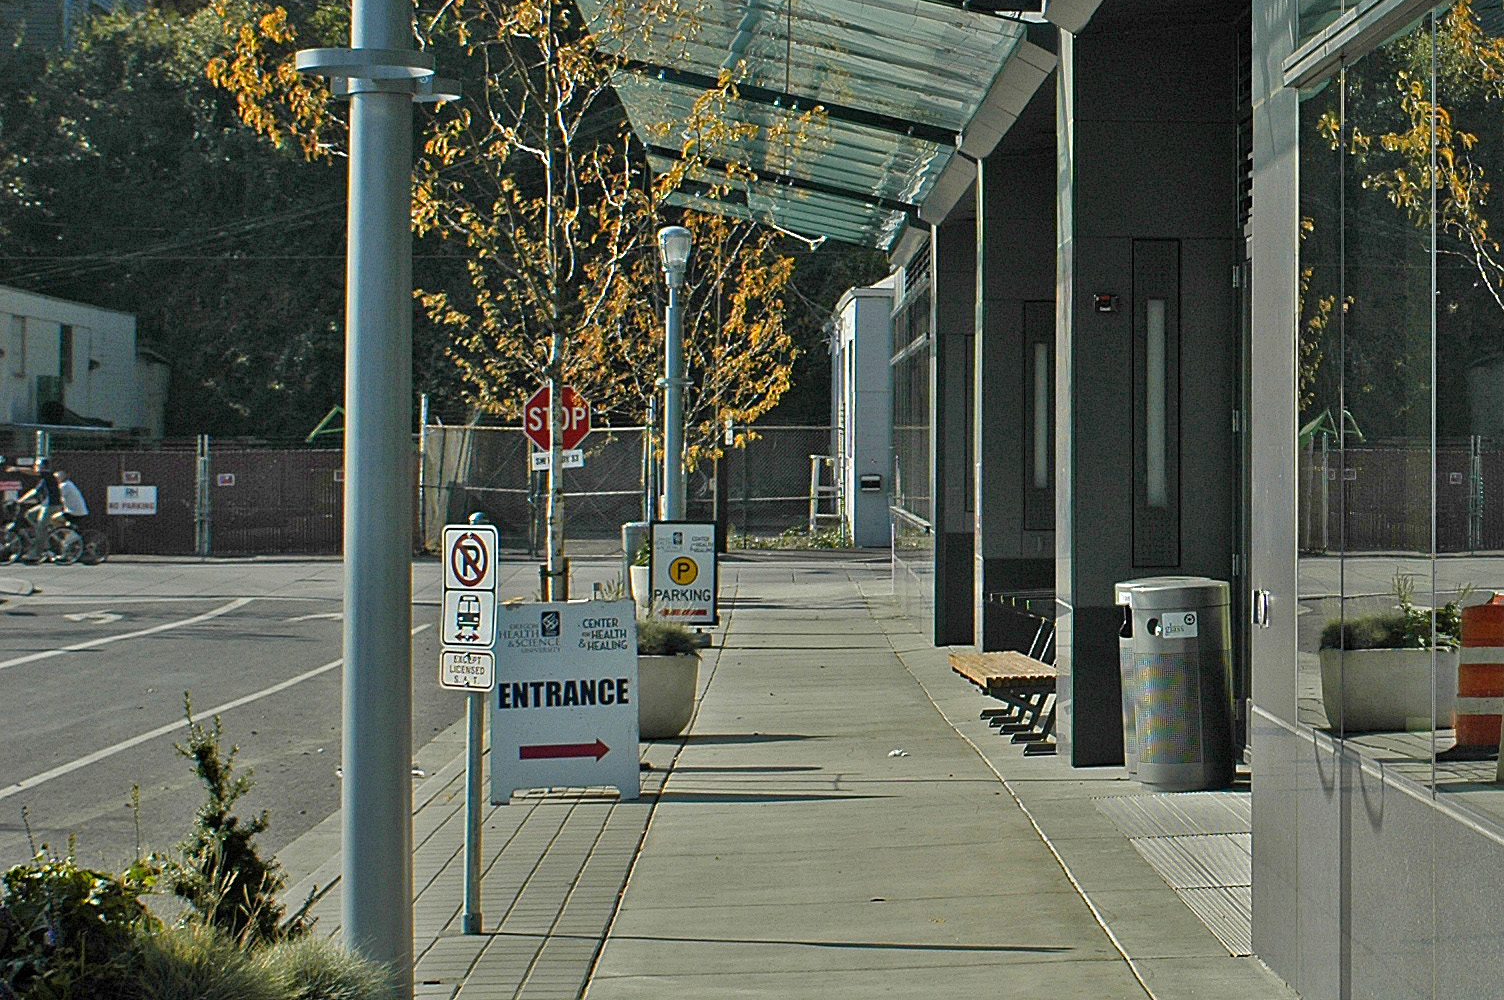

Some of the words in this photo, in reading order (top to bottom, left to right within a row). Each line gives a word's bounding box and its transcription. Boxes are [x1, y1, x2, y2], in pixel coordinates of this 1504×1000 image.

[678, 562, 690, 580] P
[653, 588, 711, 602] PARKING
[582, 617, 619, 629] CENTER
[499, 629, 539, 639] HEALTH
[591, 629, 627, 640] HEALTH
[587, 639, 628, 651] HEALING
[449, 664, 485, 675] LICENSED
[499, 679, 629, 709] ENTRANCE
